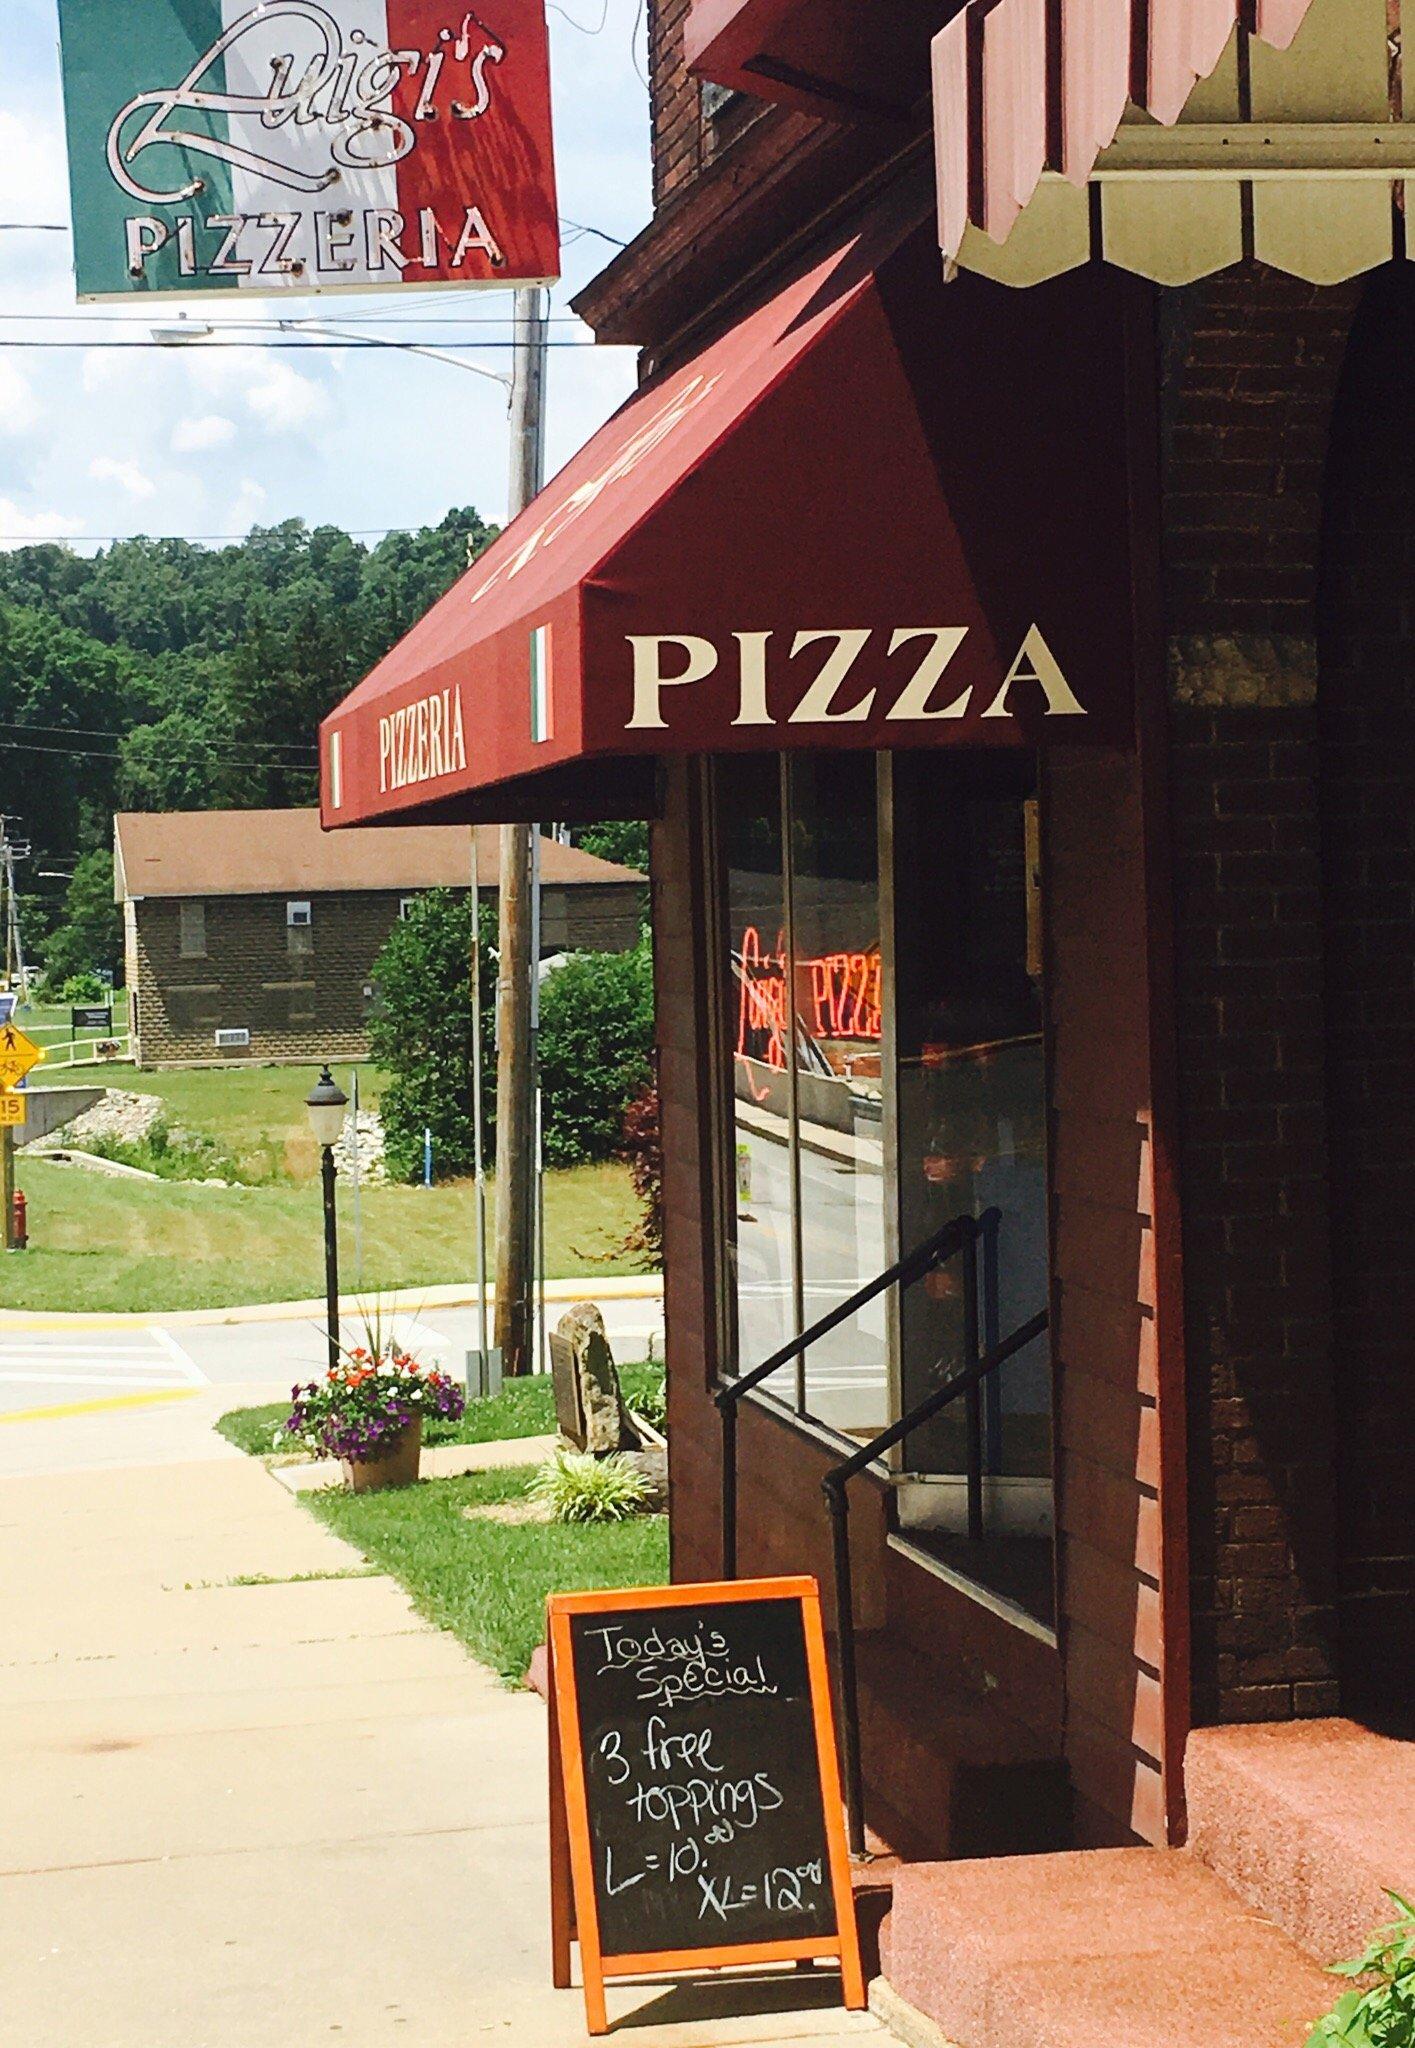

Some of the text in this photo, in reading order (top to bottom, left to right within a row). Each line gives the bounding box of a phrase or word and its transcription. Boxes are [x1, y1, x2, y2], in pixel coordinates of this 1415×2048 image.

[107, 0, 506, 203] Luigi's
[125, 207, 505, 277] PIZZERIA
[624, 623, 1088, 728] PIZZA
[379, 683, 467, 793] PIZZERIA
[1, 1099, 20, 1114] 15
[584, 1621, 729, 1669] Today's
[637, 1655, 770, 1706] Special
[600, 1716, 723, 1784] 3 free
[627, 1773, 783, 1830] toppings
